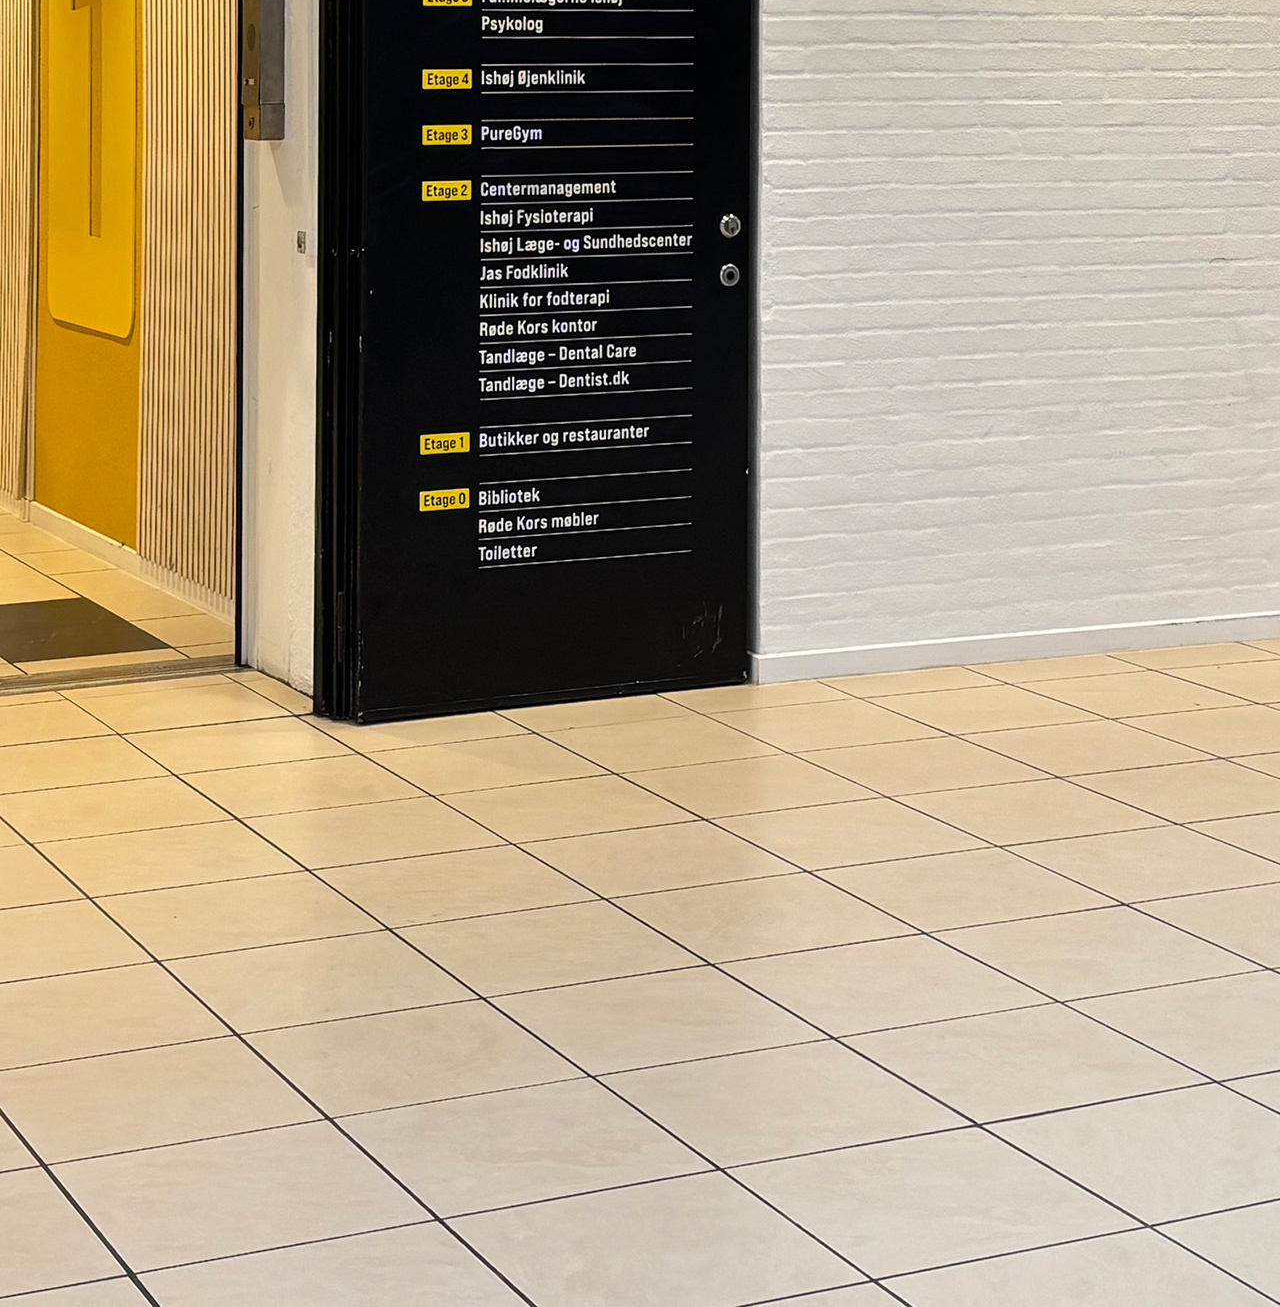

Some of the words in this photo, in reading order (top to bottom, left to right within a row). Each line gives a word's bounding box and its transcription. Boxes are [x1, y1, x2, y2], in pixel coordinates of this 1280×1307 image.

[482, 16, 543, 33] Psykolog
[427, 73, 460, 86] Etage
[462, 73, 469, 85] 4
[482, 70, 513, 87] Ishøj
[518, 70, 585, 87] Øjenklinik
[426, 129, 459, 143] Etage
[461, 129, 468, 140] 3
[482, 126, 542, 143] PureGym
[426, 185, 459, 199] Etage
[461, 184, 468, 195] 2
[481, 180, 616, 197] Centermanagement
[481, 210, 513, 227] Ishøj
[517, 208, 593, 226] Fysioterapi
[481, 237, 512, 254] Ishøj
[517, 237, 560, 253] Læge-
[564, 239, 579, 252] og
[584, 234, 692, 249] Sundhedscenter
[480, 266, 502, 280] Jas
[506, 264, 568, 279] Fodklinik
[480, 293, 518, 308] Klinik
[523, 293, 543, 306] for
[547, 290, 609, 306] fodterapi
[480, 321, 513, 336] Røde
[518, 320, 548, 334] Kors
[552, 319, 597, 333] kontor
[479, 349, 545, 365] Tandlæge
[560, 346, 602, 360] Dental
[607, 344, 636, 358] Care
[479, 377, 544, 392] Tandlæge
[560, 371, 629, 388] Dentist.dk
[424, 438, 456, 450] Etage
[459, 437, 465, 448] 1
[480, 431, 539, 447] Butikker
[543, 434, 558, 446] og
[563, 426, 649, 442] restauranter
[423, 494, 456, 506] Etage
[458, 493, 466, 504] 0
[479, 488, 540, 505] Bibliotek
[479, 518, 512, 533] Røde
[517, 516, 547, 530] Kors
[552, 512, 599, 528] møbler
[478, 545, 537, 561] Toiletter
